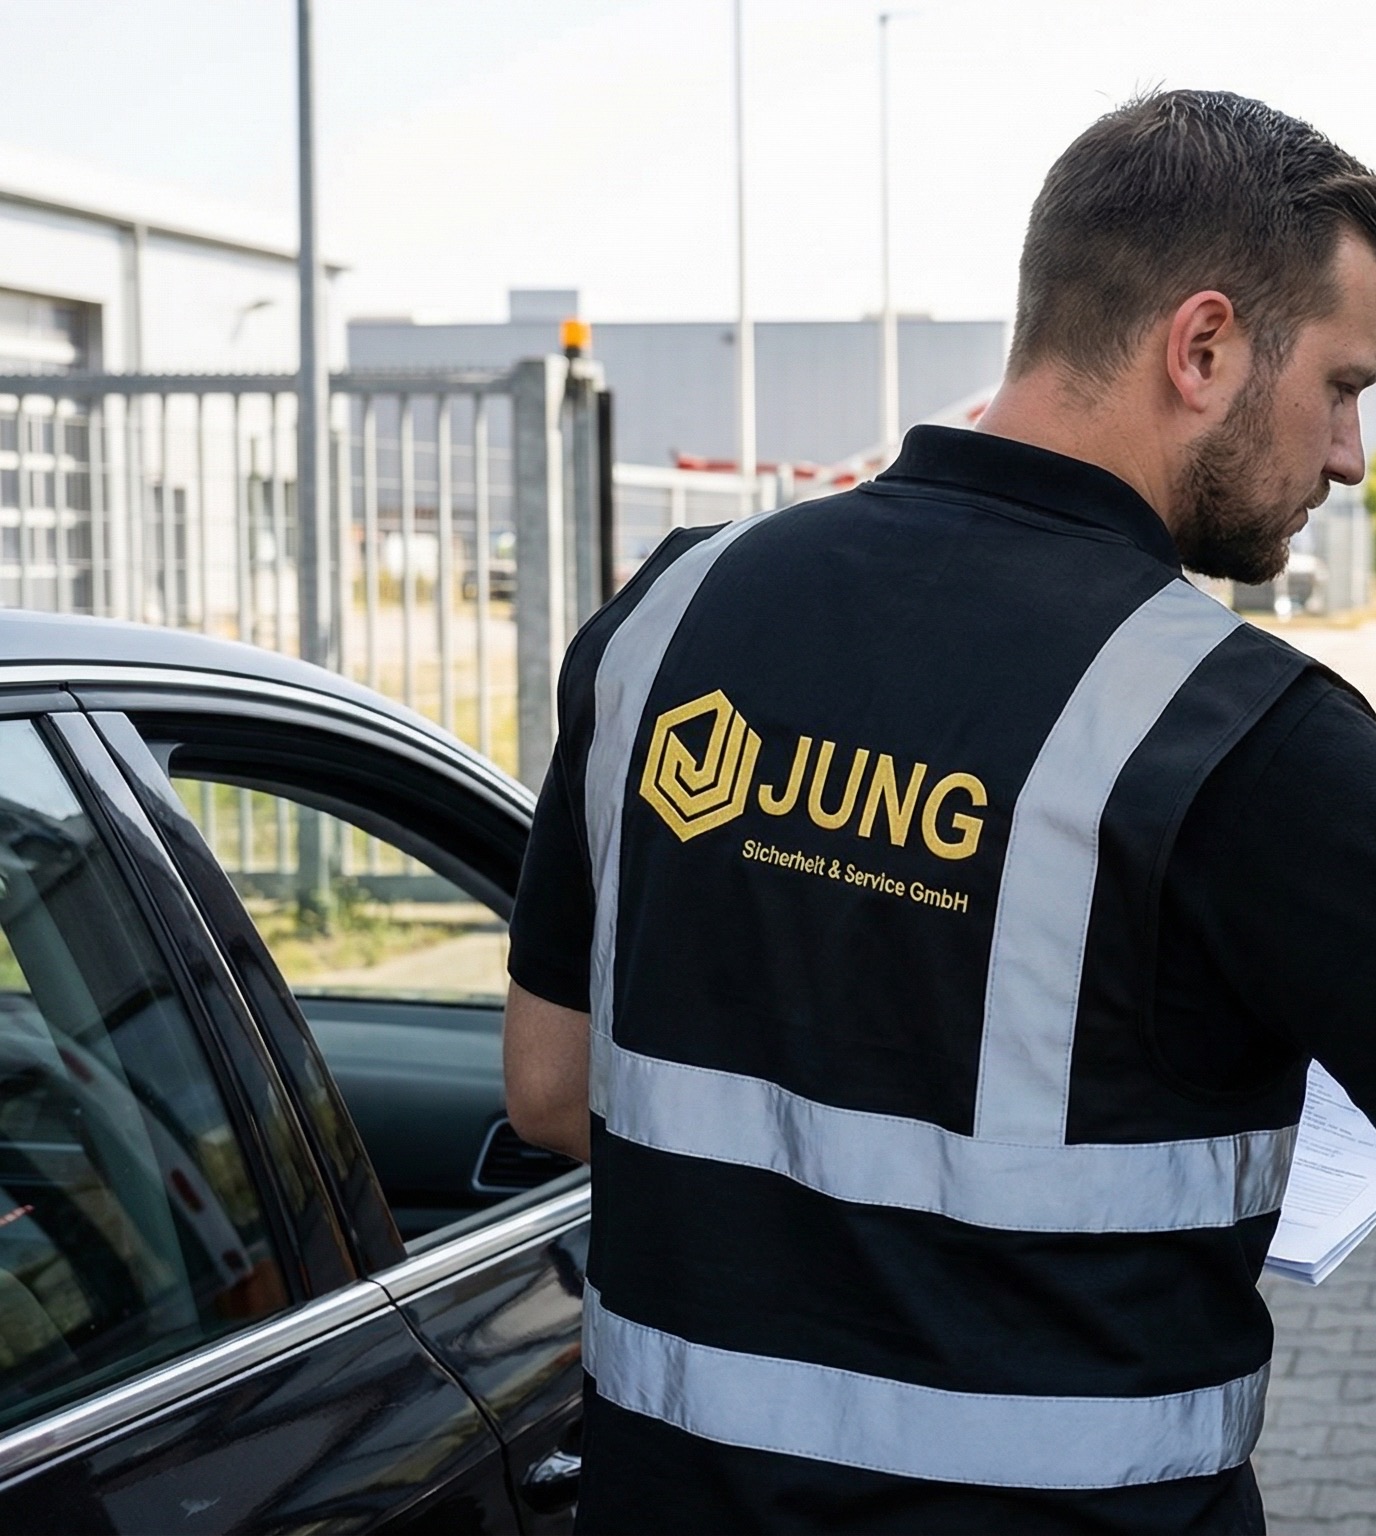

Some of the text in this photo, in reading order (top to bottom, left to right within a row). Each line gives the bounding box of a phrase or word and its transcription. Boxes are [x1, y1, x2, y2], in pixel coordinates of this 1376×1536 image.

[758, 735, 988, 860] JUNG
[742, 840, 968, 913] Sicherheit & Service GmbH
